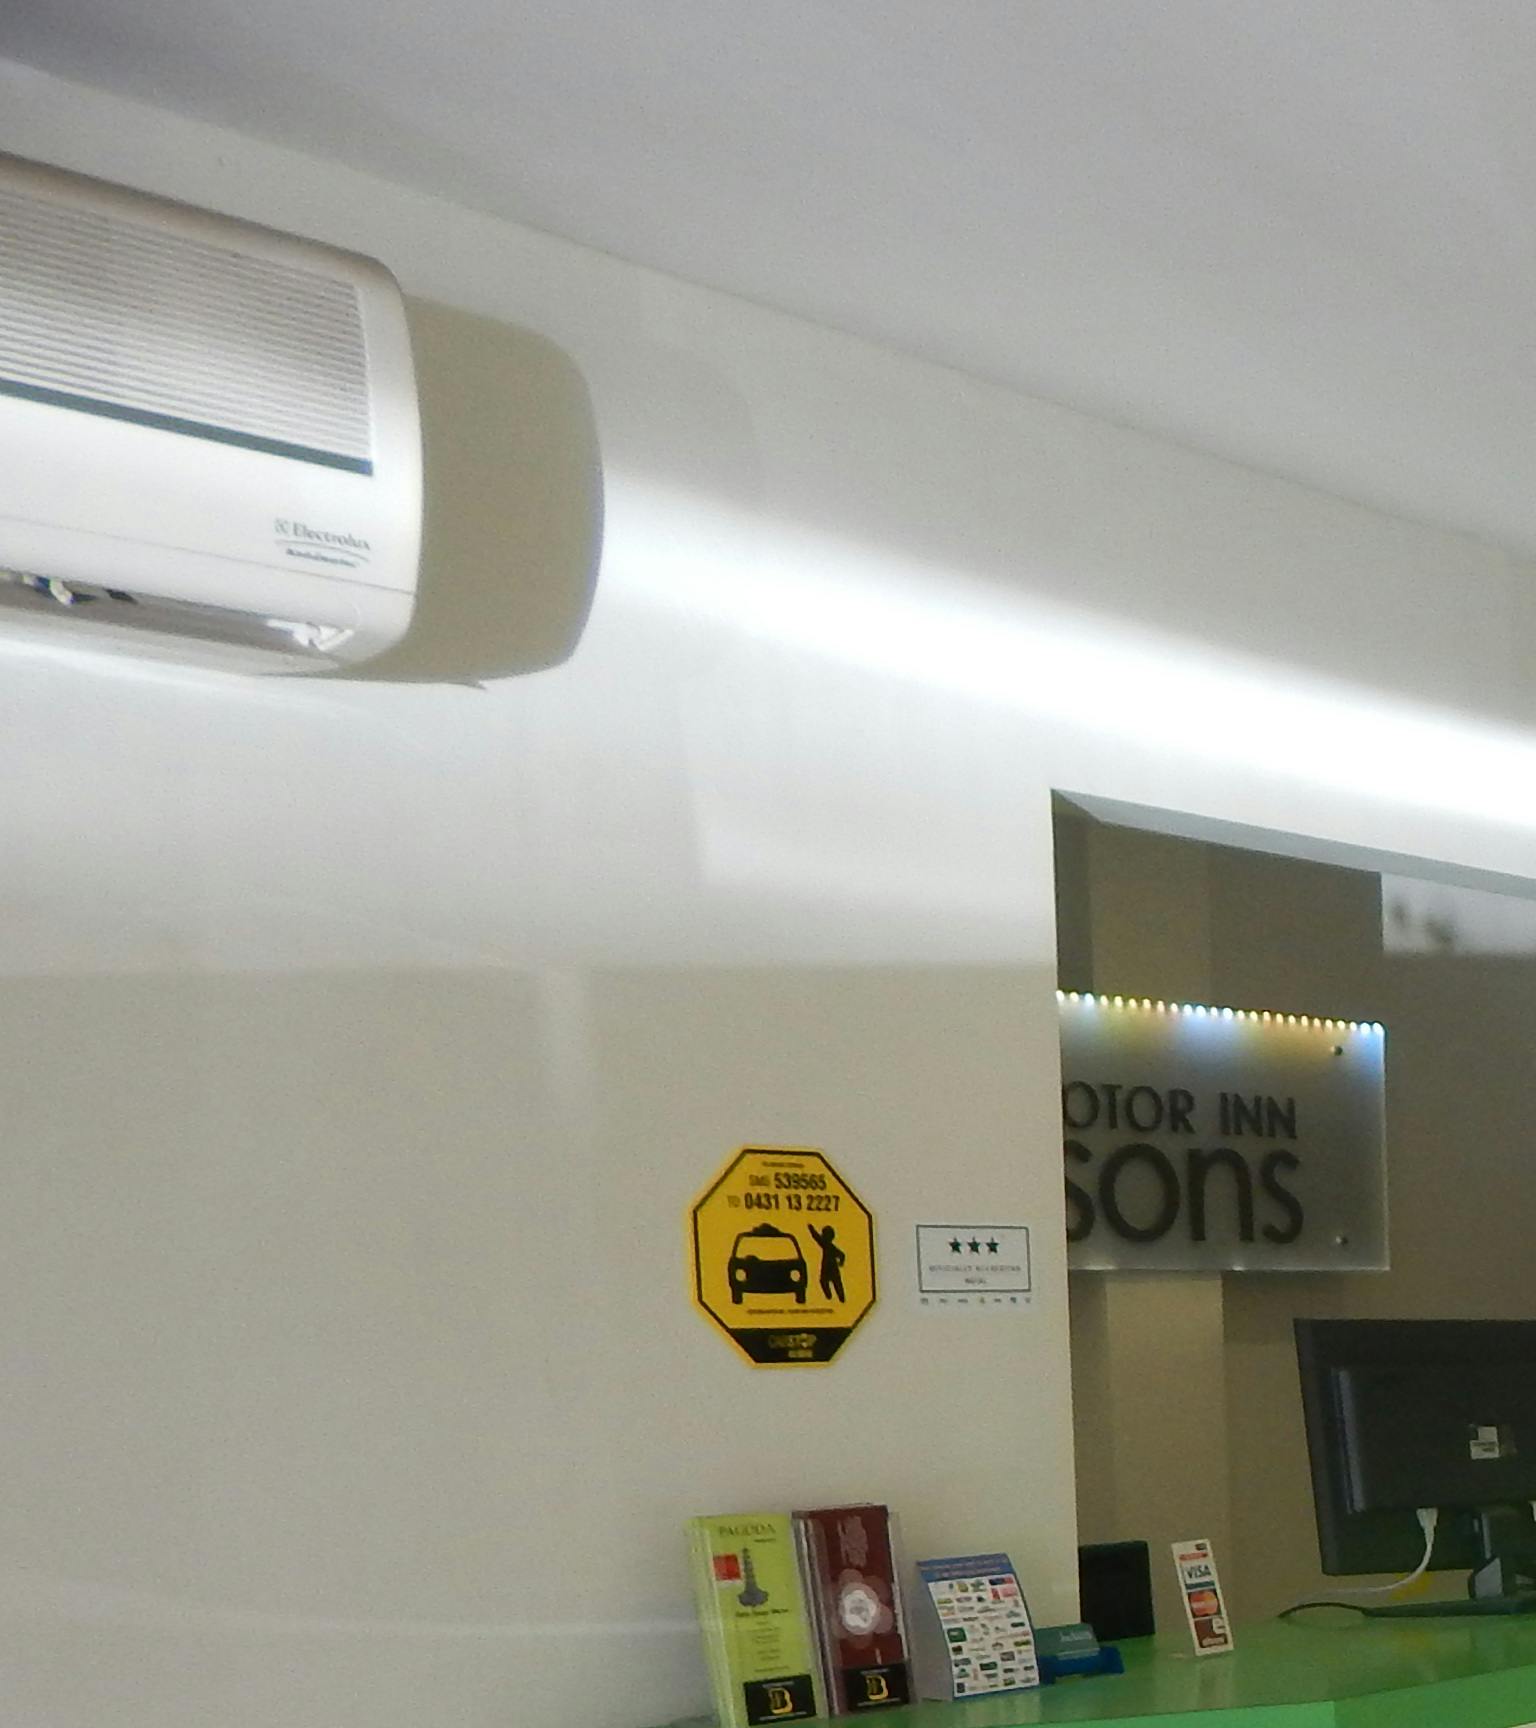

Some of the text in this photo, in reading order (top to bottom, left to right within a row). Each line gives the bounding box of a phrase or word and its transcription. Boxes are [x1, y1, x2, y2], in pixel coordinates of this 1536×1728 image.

[293, 520, 372, 552] Electrolux
[1219, 1092, 1297, 1139] INN
[745, 1192, 779, 1209] 0431
[786, 1194, 801, 1210] 13
[807, 1195, 839, 1211] 2227
[719, 1524, 776, 1536] PAGODA
[1186, 1564, 1211, 1579] VISA
